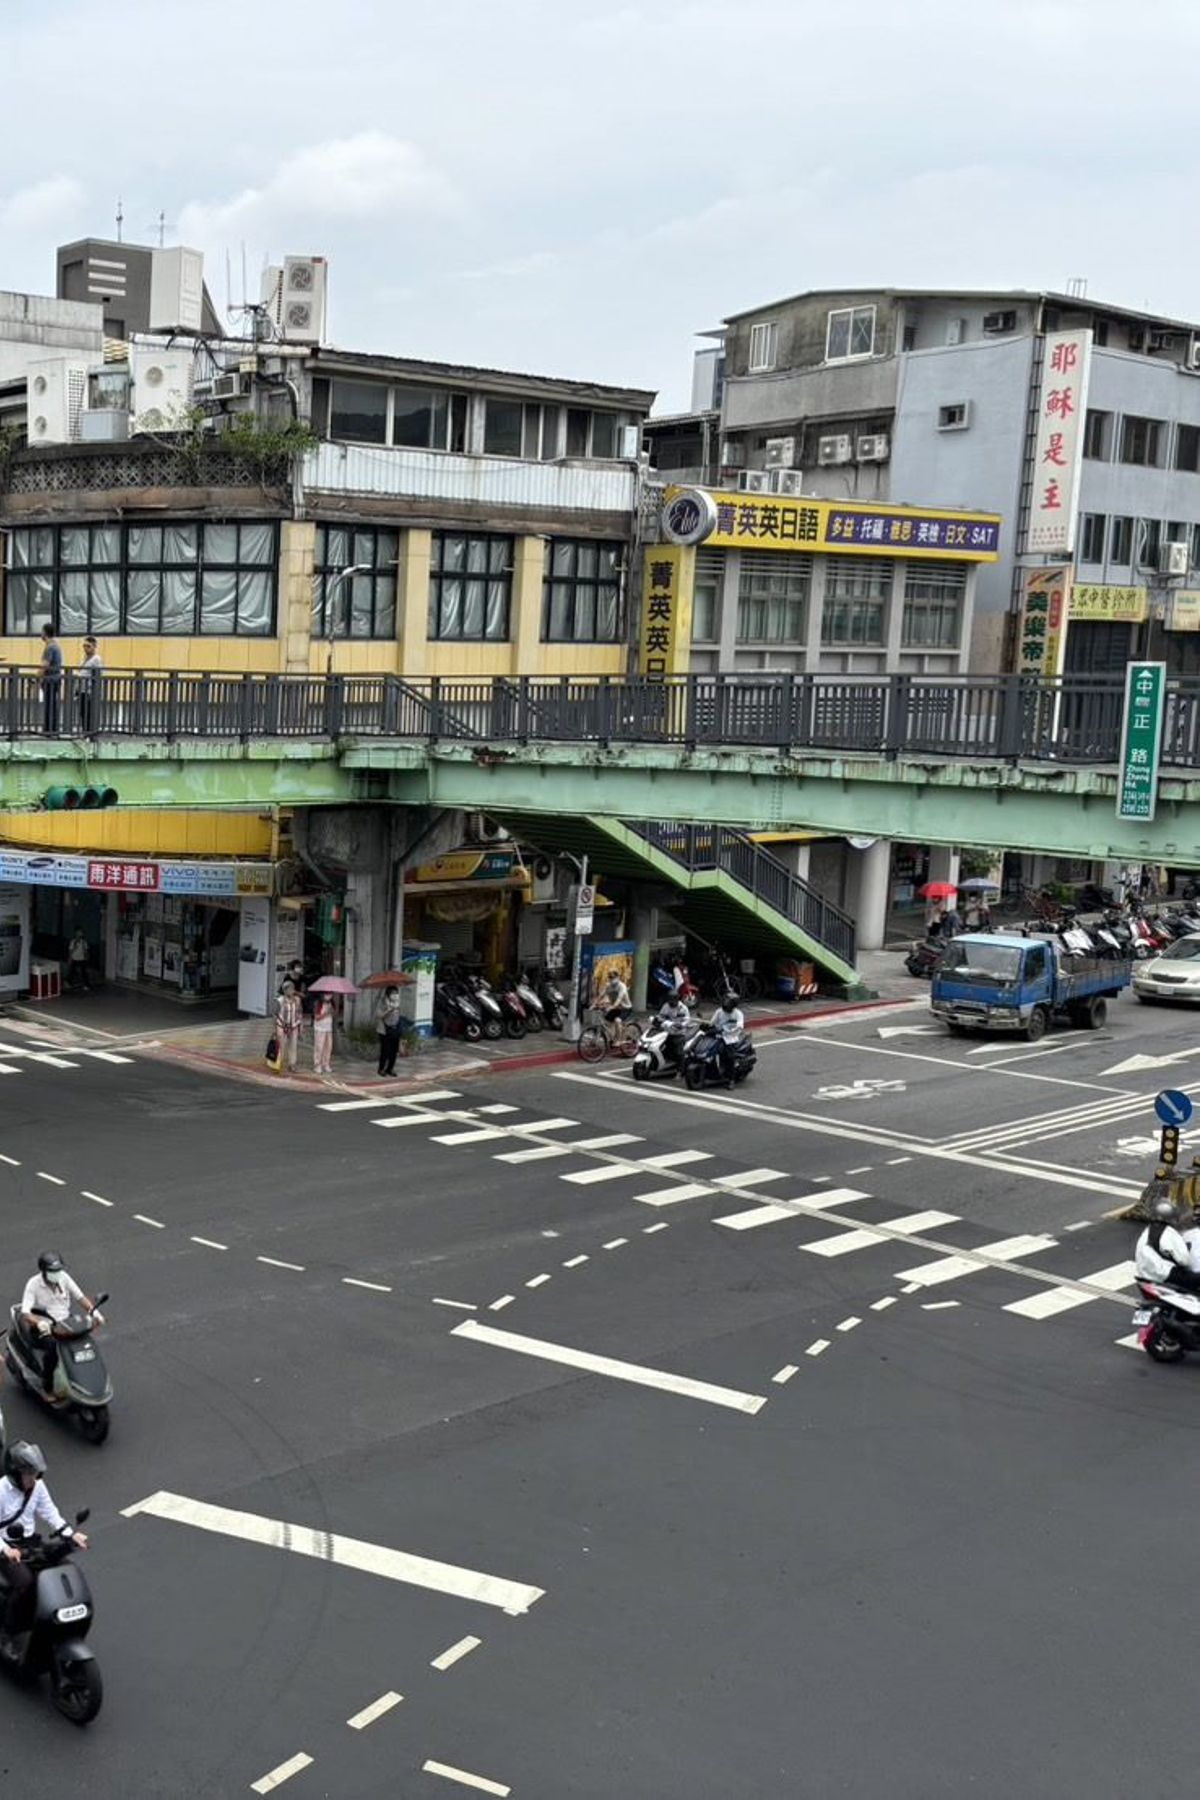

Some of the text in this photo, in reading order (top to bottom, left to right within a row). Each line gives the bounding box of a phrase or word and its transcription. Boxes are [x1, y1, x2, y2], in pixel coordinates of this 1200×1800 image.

[1040, 341, 1078, 511] 耶穌是主
[715, 500, 819, 542] 菁英英日語
[1130, 679, 1153, 764] 中正路
